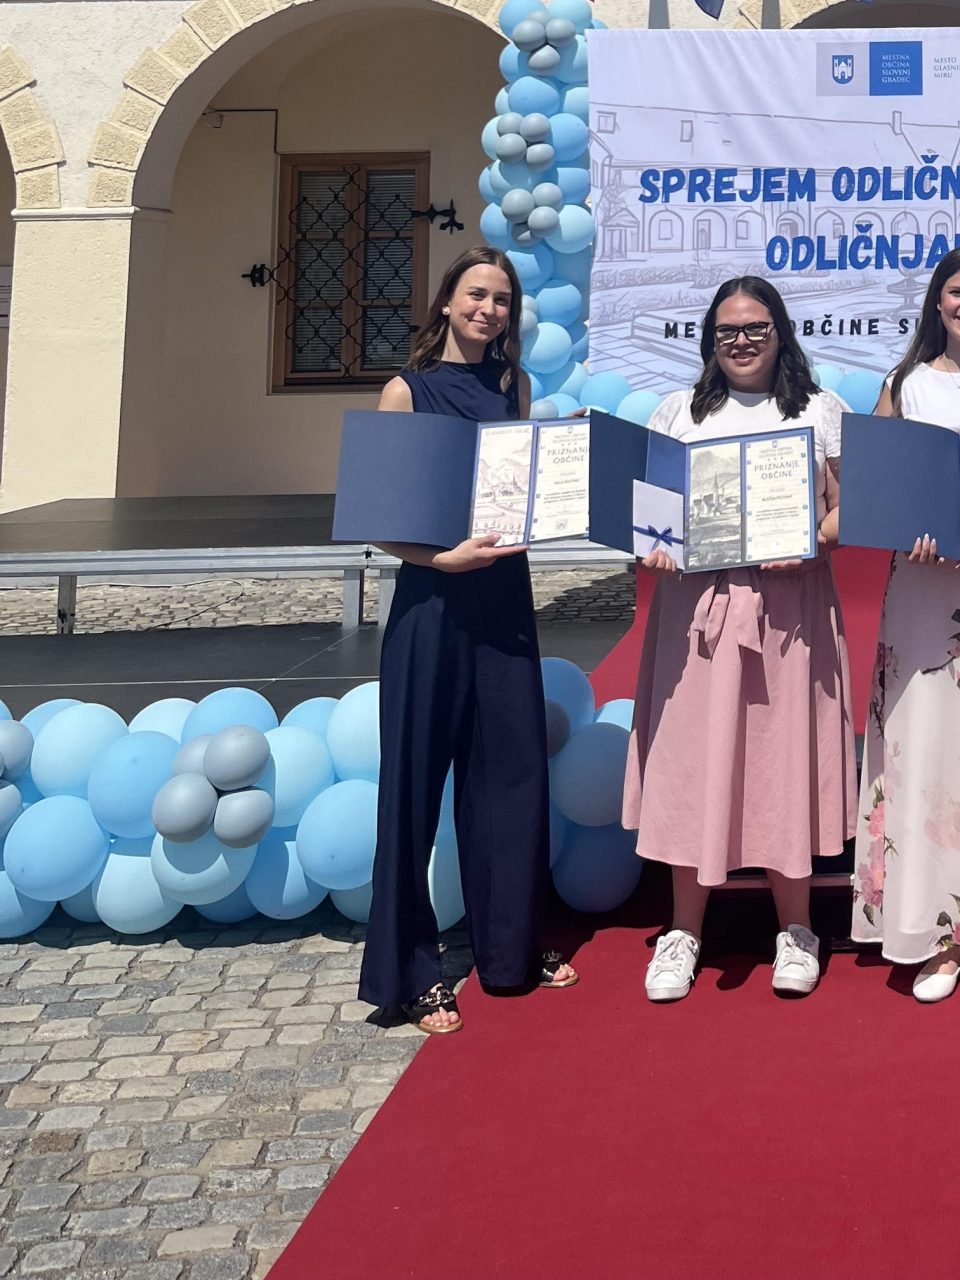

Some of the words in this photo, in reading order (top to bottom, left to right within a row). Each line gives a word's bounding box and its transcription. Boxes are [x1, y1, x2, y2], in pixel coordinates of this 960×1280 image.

[638, 167, 816, 203] SPREJEM
[547, 447, 588, 456] PRIZNANJ
[754, 460, 800, 472] PRIZNANJE
[761, 470, 792, 480] OBČINE
